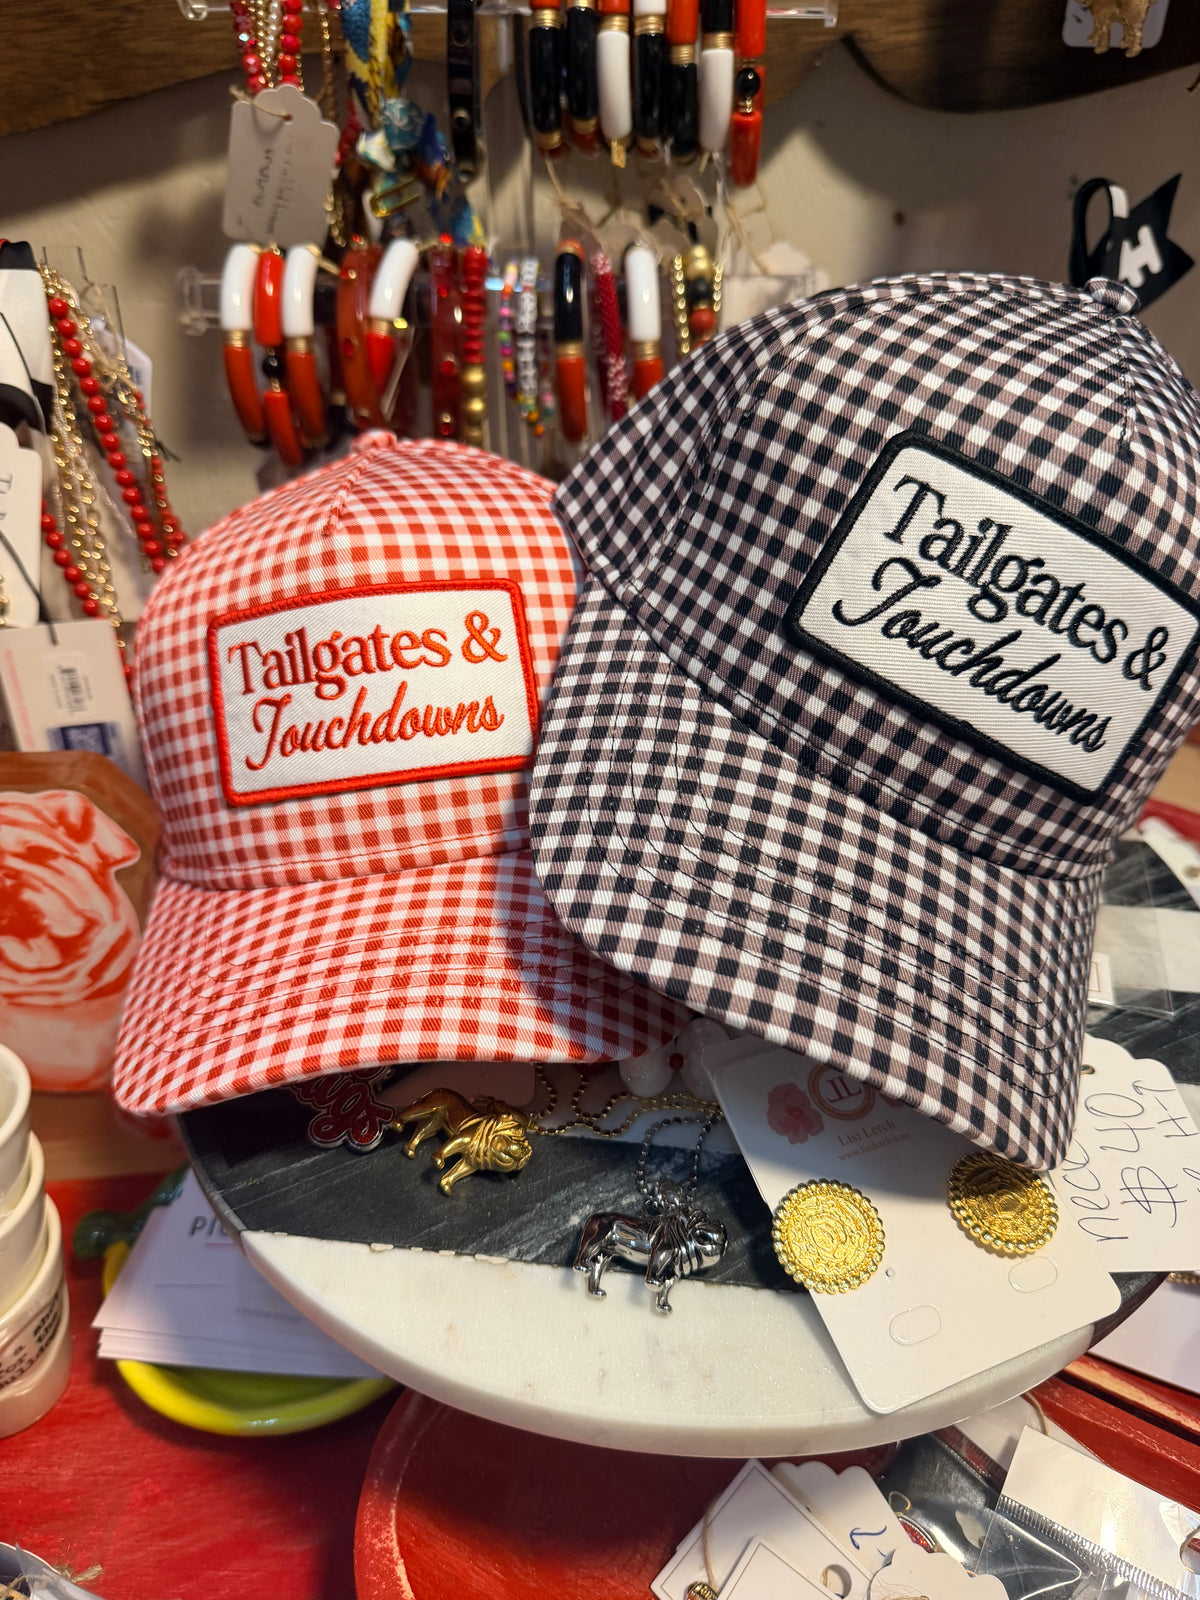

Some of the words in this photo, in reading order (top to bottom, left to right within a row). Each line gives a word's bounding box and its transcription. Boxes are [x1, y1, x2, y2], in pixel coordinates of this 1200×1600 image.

[883, 474, 1128, 665] Tailgates
[1122, 626, 1169, 691] &
[228, 624, 452, 700] Tailgates
[461, 610, 508, 663] &
[245, 681, 505, 771] Touchdowns
[832, 556, 1112, 754] Touchdowns
